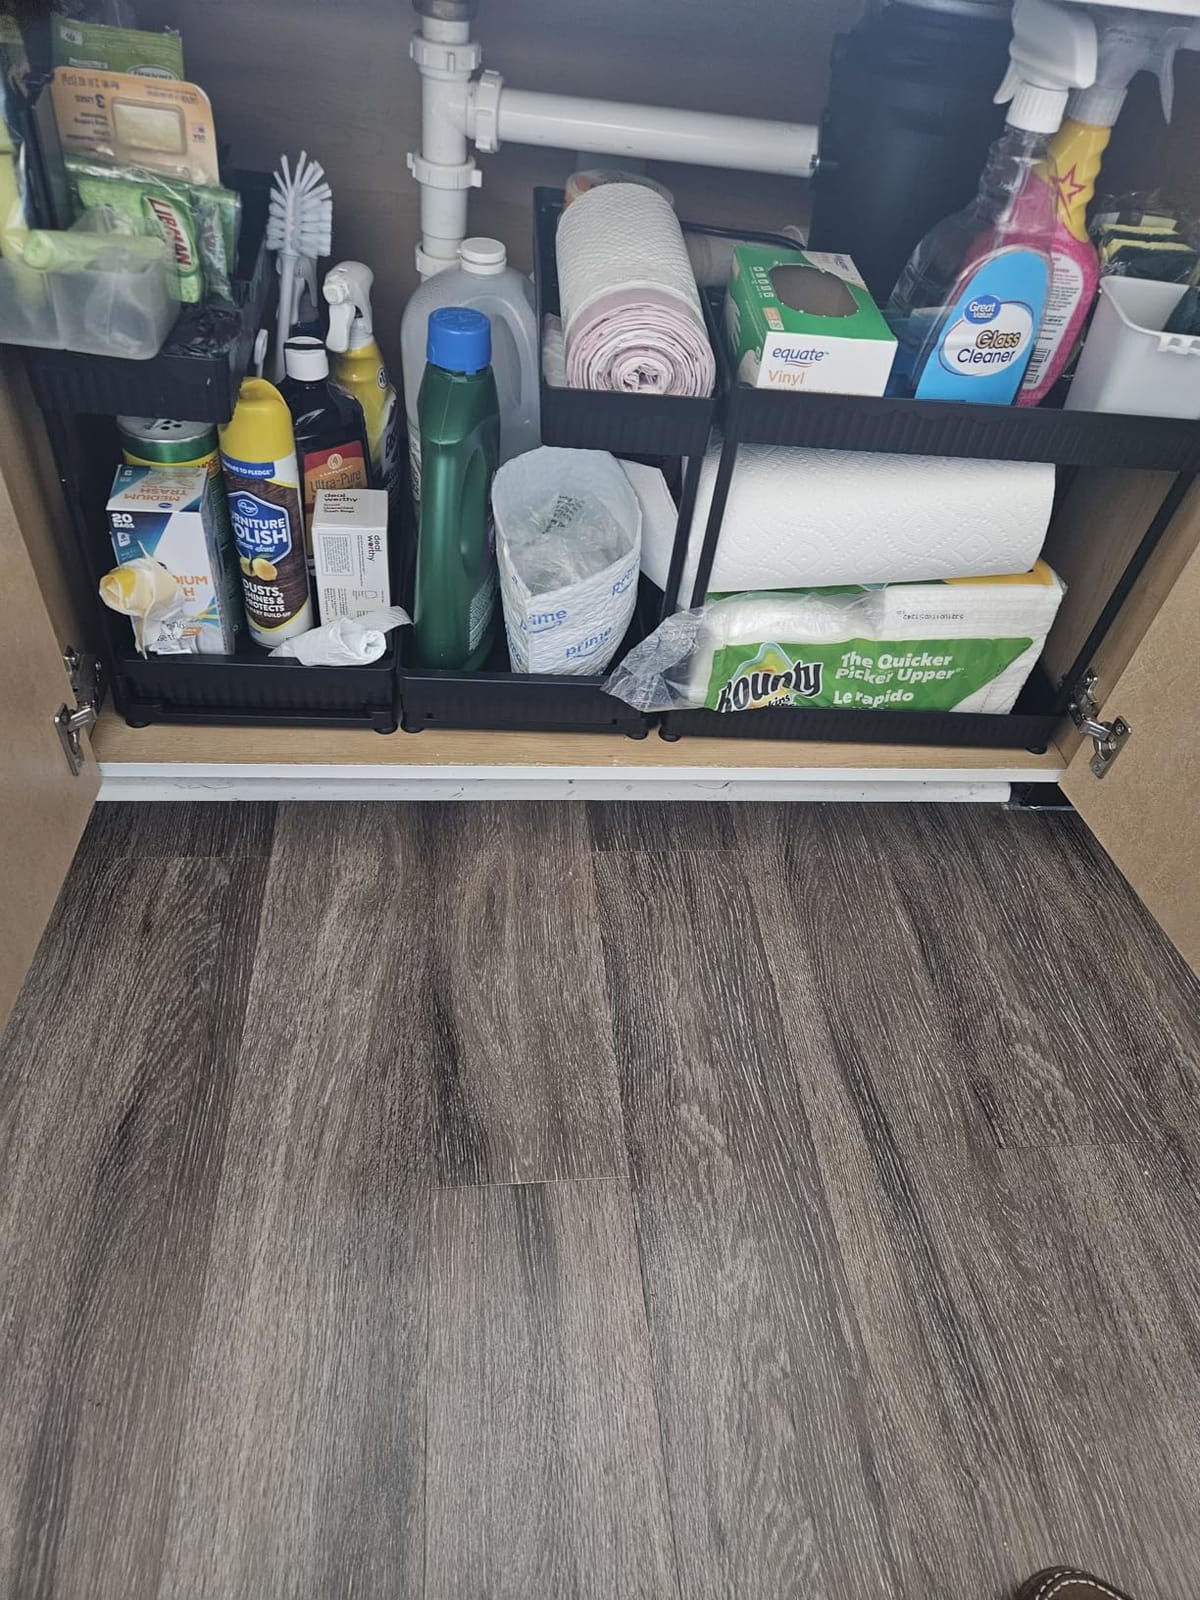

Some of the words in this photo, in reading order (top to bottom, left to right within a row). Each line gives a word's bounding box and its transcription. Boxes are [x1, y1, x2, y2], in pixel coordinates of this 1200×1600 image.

[968, 301, 996, 314] Great
[975, 329, 1021, 350] Glass
[772, 347, 825, 362] equate
[957, 348, 1016, 364] Cleaner
[768, 369, 805, 386] Vinyl
[124, 492, 180, 502] MEDIUM
[140, 487, 187, 496] TRASH
[112, 513, 133, 523] 20
[233, 512, 286, 530] RNITURE
[233, 522, 288, 545] OLISH
[367, 534, 377, 562] worthy
[373, 534, 382, 553] deal
[841, 651, 874, 669] The
[877, 653, 953, 670] Quicker
[835, 667, 894, 685] Picker
[897, 668, 955, 683] Upper
[834, 690, 853, 705] Le
[855, 688, 915, 707] rapido
